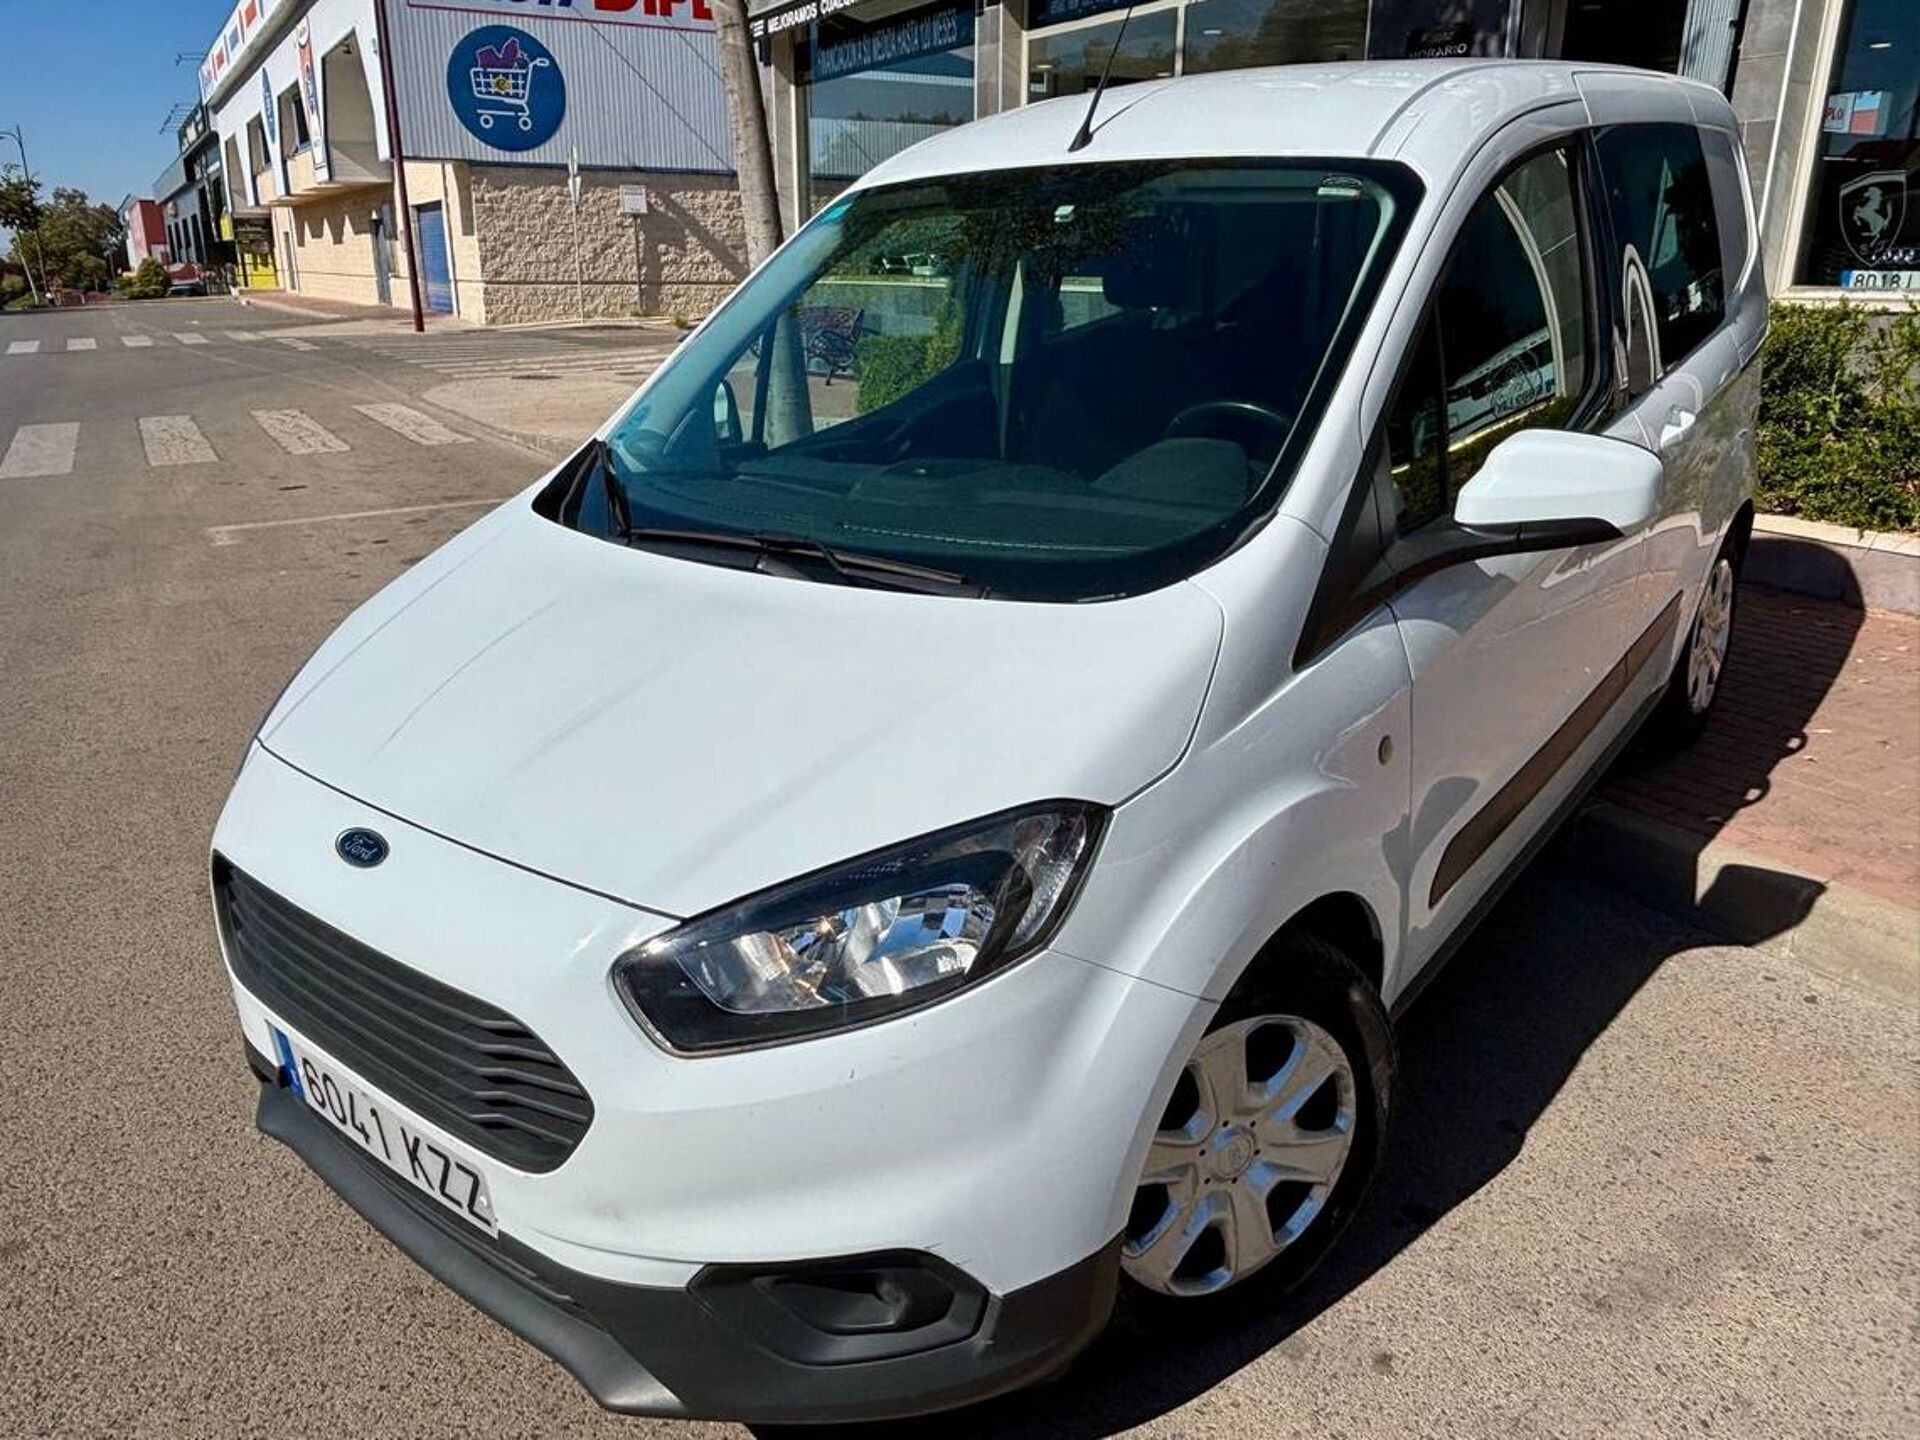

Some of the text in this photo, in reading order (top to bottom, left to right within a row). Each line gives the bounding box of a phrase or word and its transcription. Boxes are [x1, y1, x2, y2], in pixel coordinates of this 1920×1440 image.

[768, 3, 817, 33] MEJORAMOS
[303, 1057, 493, 1228] 6041 KZZ
